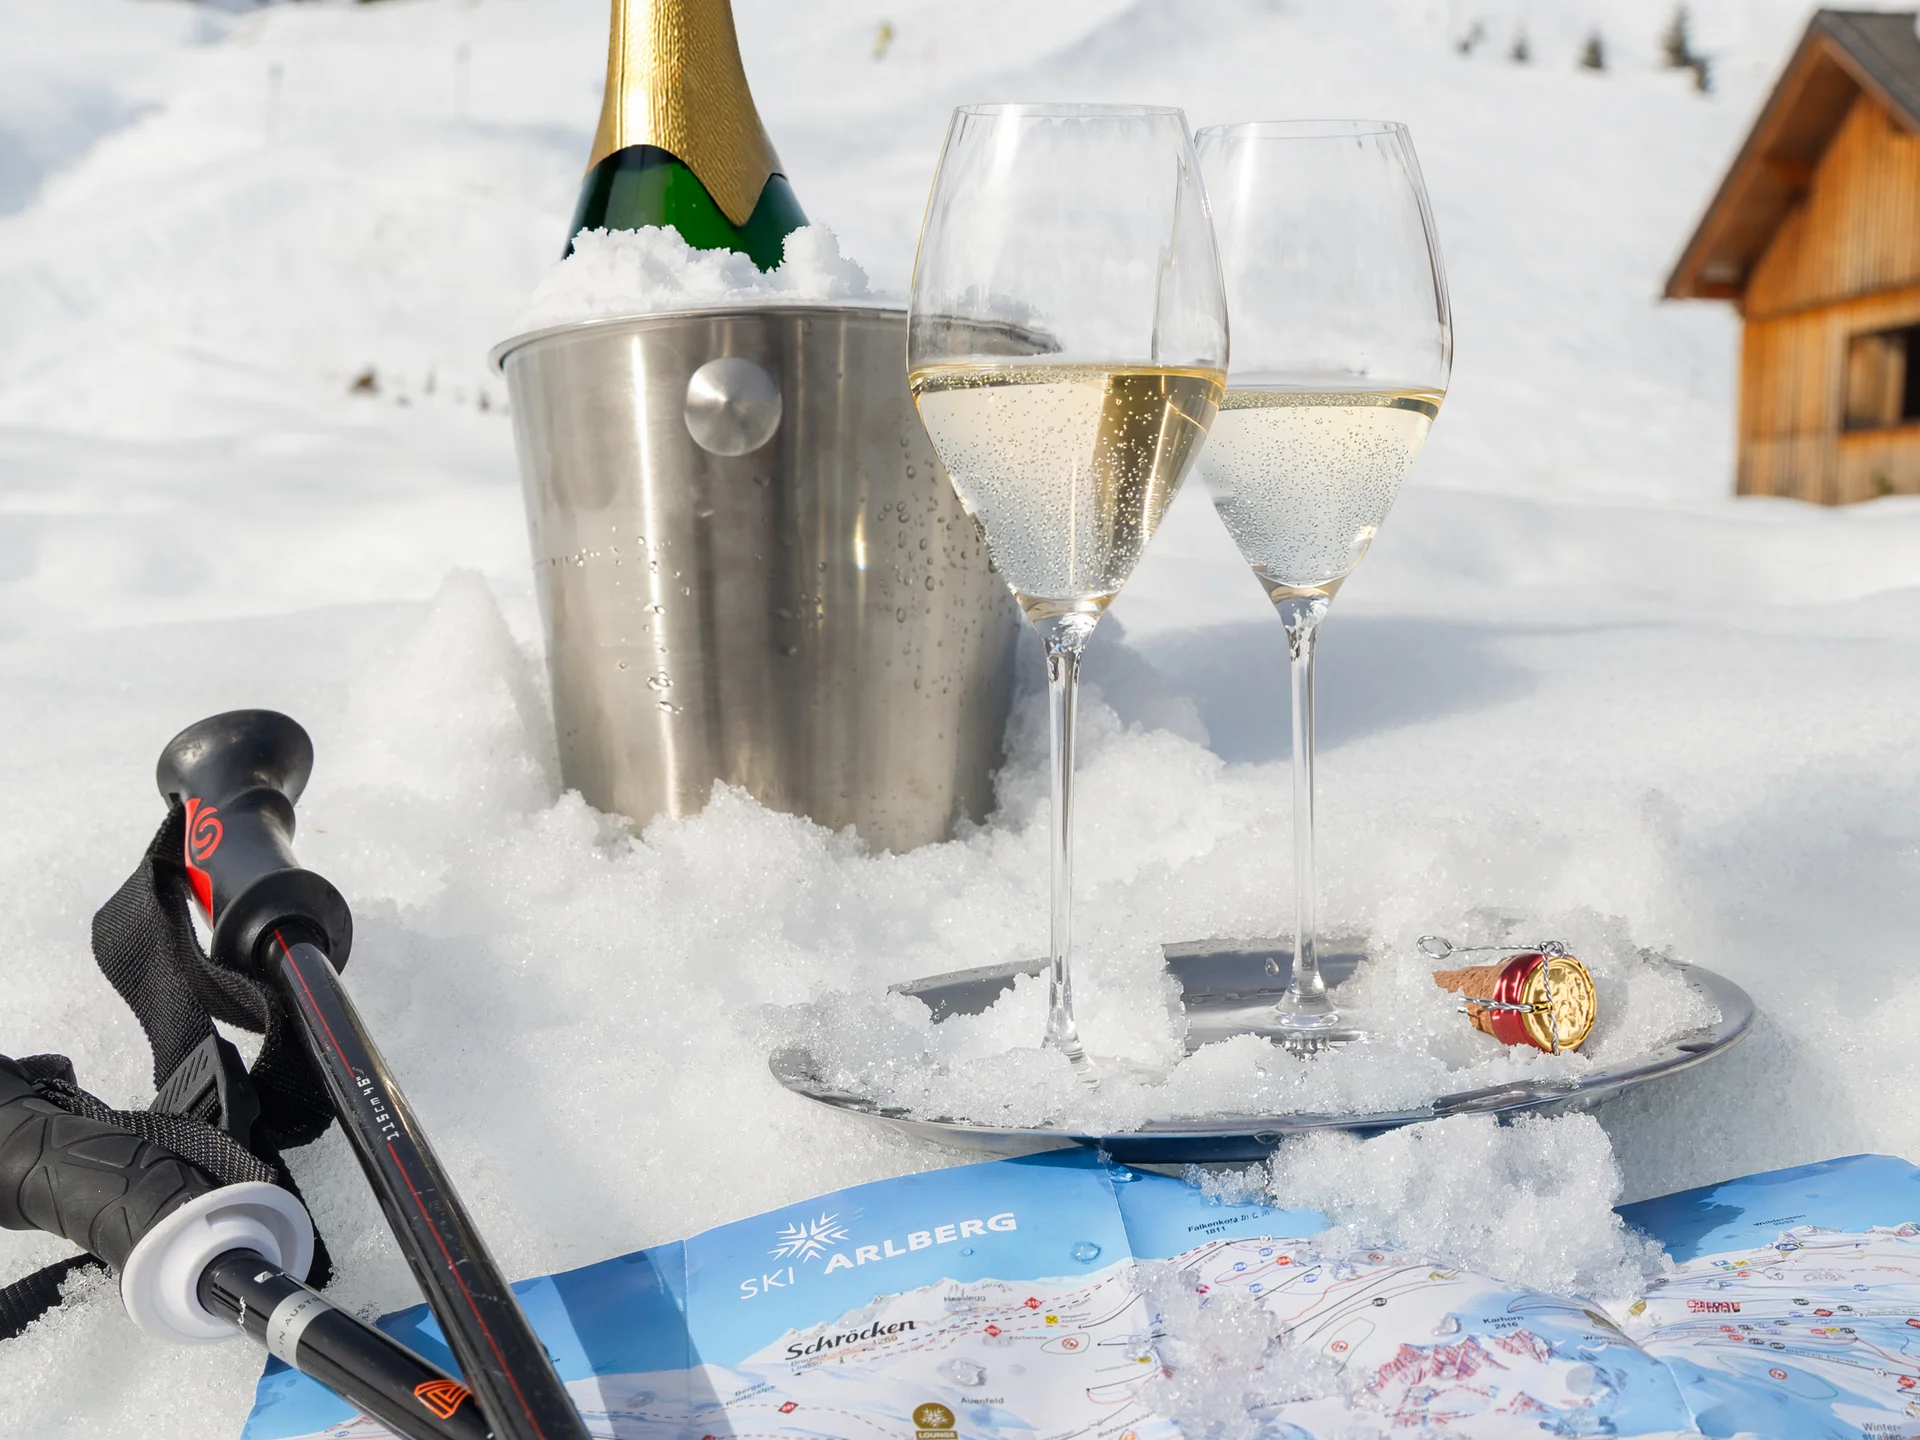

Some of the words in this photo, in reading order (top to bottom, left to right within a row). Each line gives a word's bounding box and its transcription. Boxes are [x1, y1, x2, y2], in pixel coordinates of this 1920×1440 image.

[370, 1096, 400, 1141] 115cm
[739, 1266, 796, 1300] SKI
[824, 1212, 1018, 1274] ARLBERG
[1483, 1315, 1524, 1324] Karhorn
[785, 1320, 916, 1360] Schröcken
[1862, 1422, 1901, 1431] Winter-
